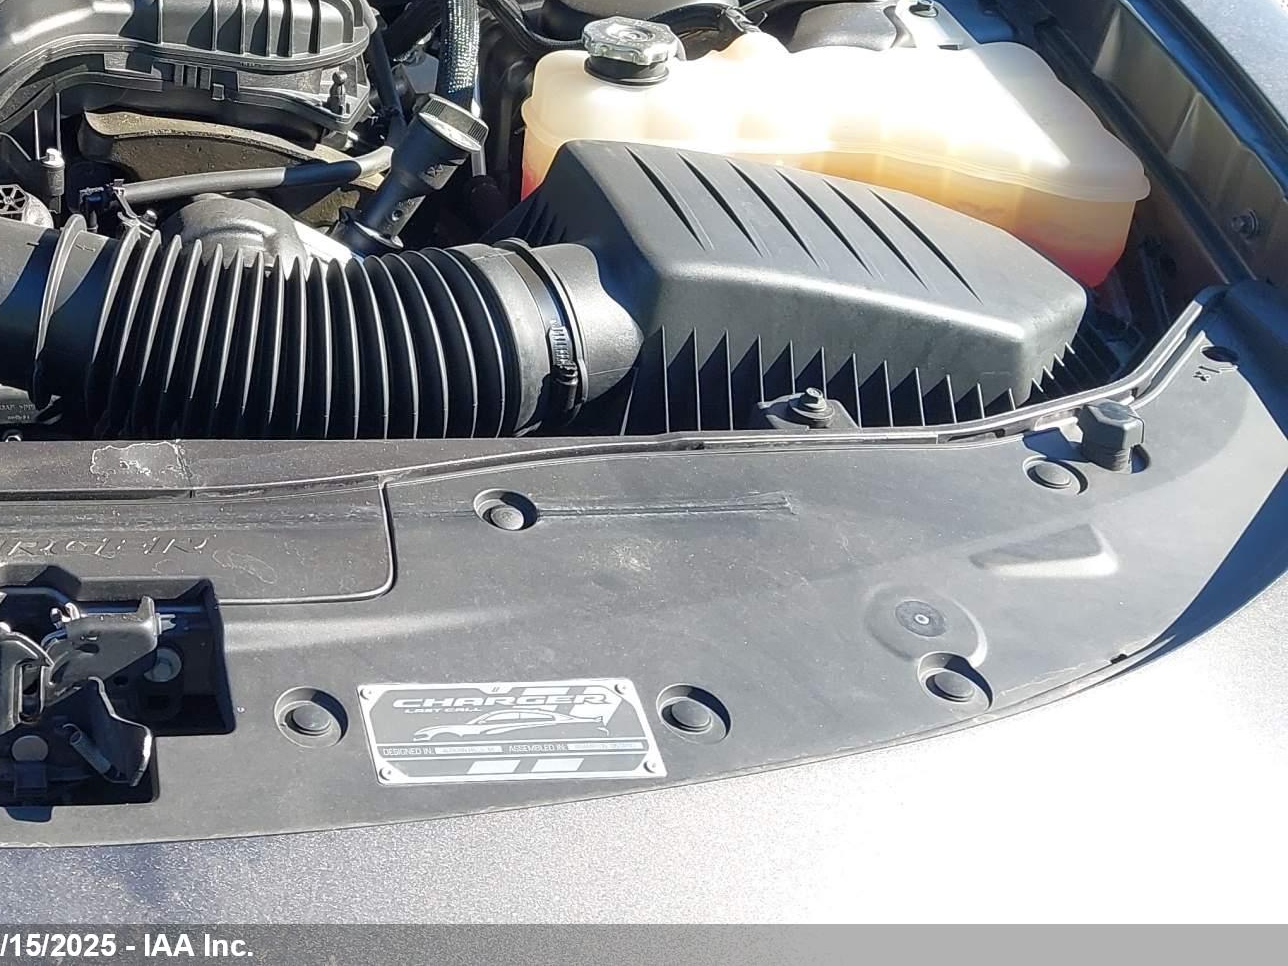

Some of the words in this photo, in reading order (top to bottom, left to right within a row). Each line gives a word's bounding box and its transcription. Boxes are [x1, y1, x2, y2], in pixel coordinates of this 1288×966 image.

[392, 694, 613, 709] CHARGER
[382, 747, 422, 755] DESIGNED
[509, 743, 555, 752] ASSEMBLED
